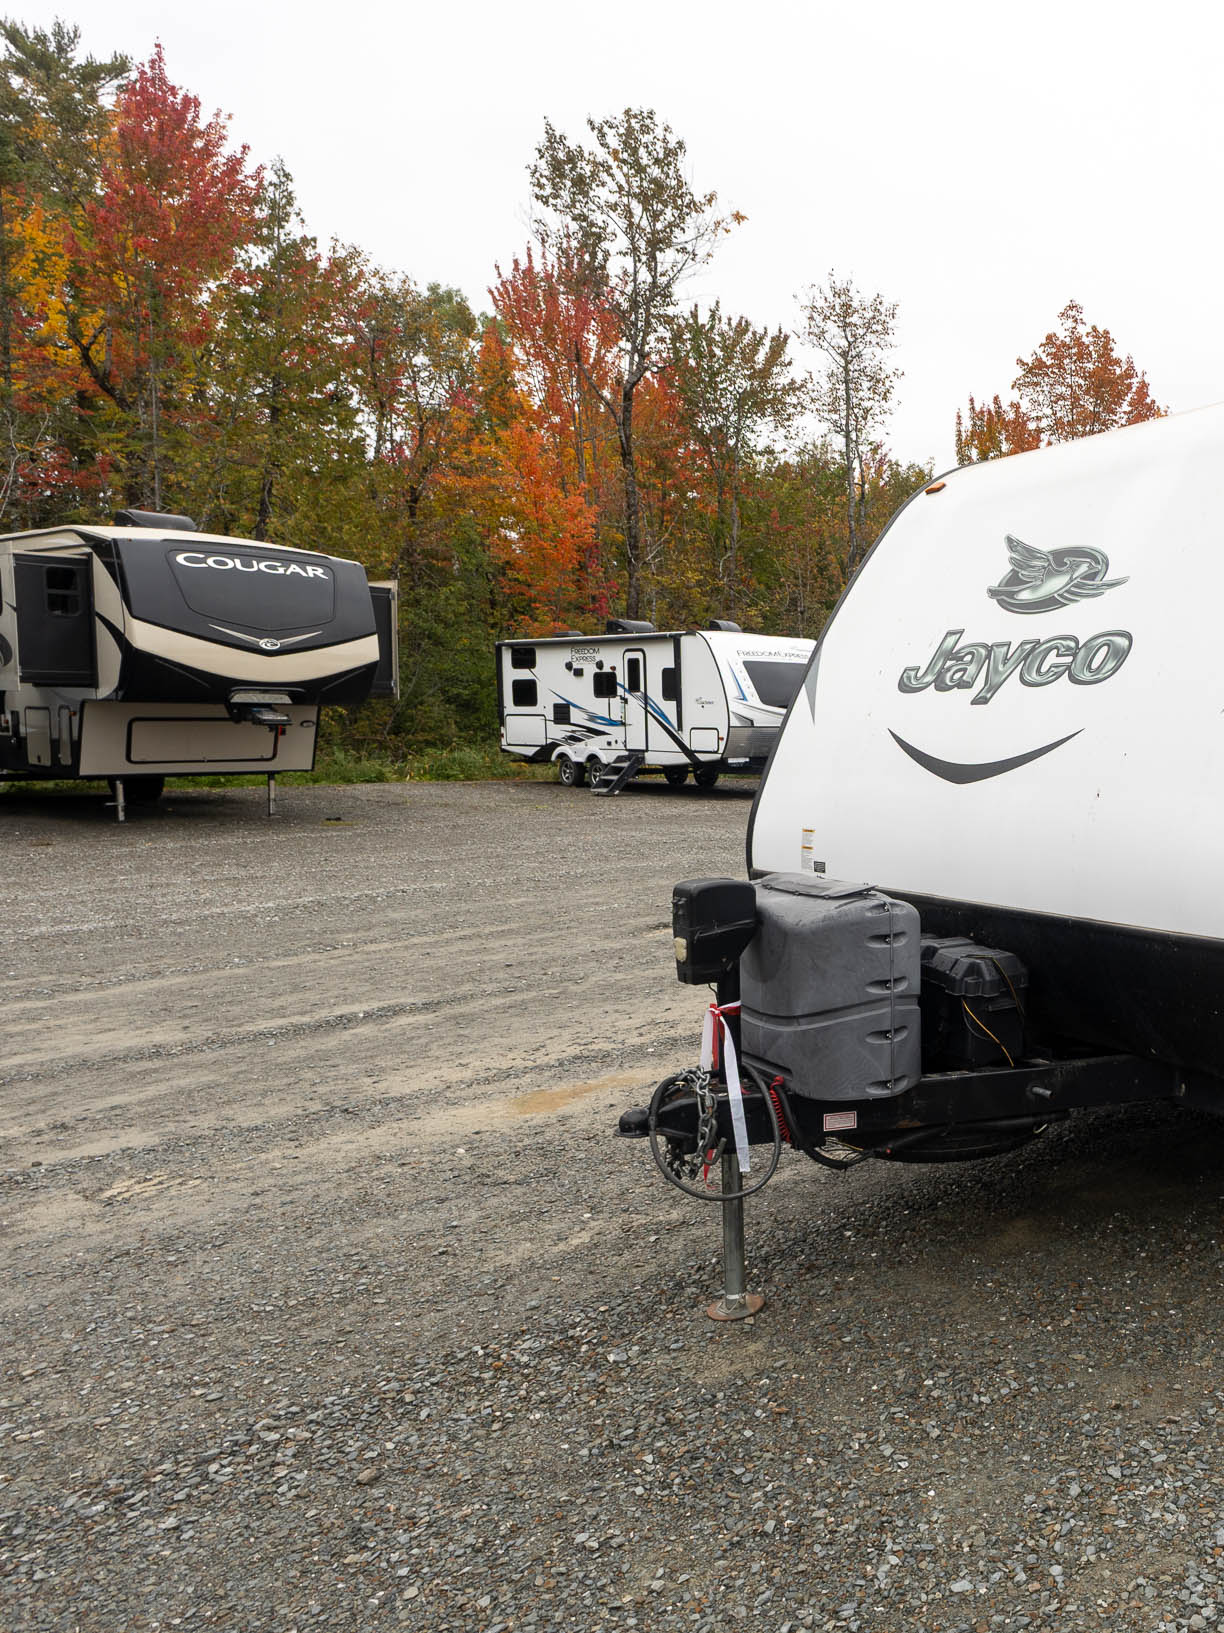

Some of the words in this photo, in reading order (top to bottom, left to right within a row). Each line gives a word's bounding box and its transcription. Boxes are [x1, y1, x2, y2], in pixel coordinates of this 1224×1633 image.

[175, 552, 329, 580] COUGAR
[570, 647, 600, 655] FREEDOM
[570, 655, 597, 663] EXPRESS
[897, 628, 1134, 705] Jayco
